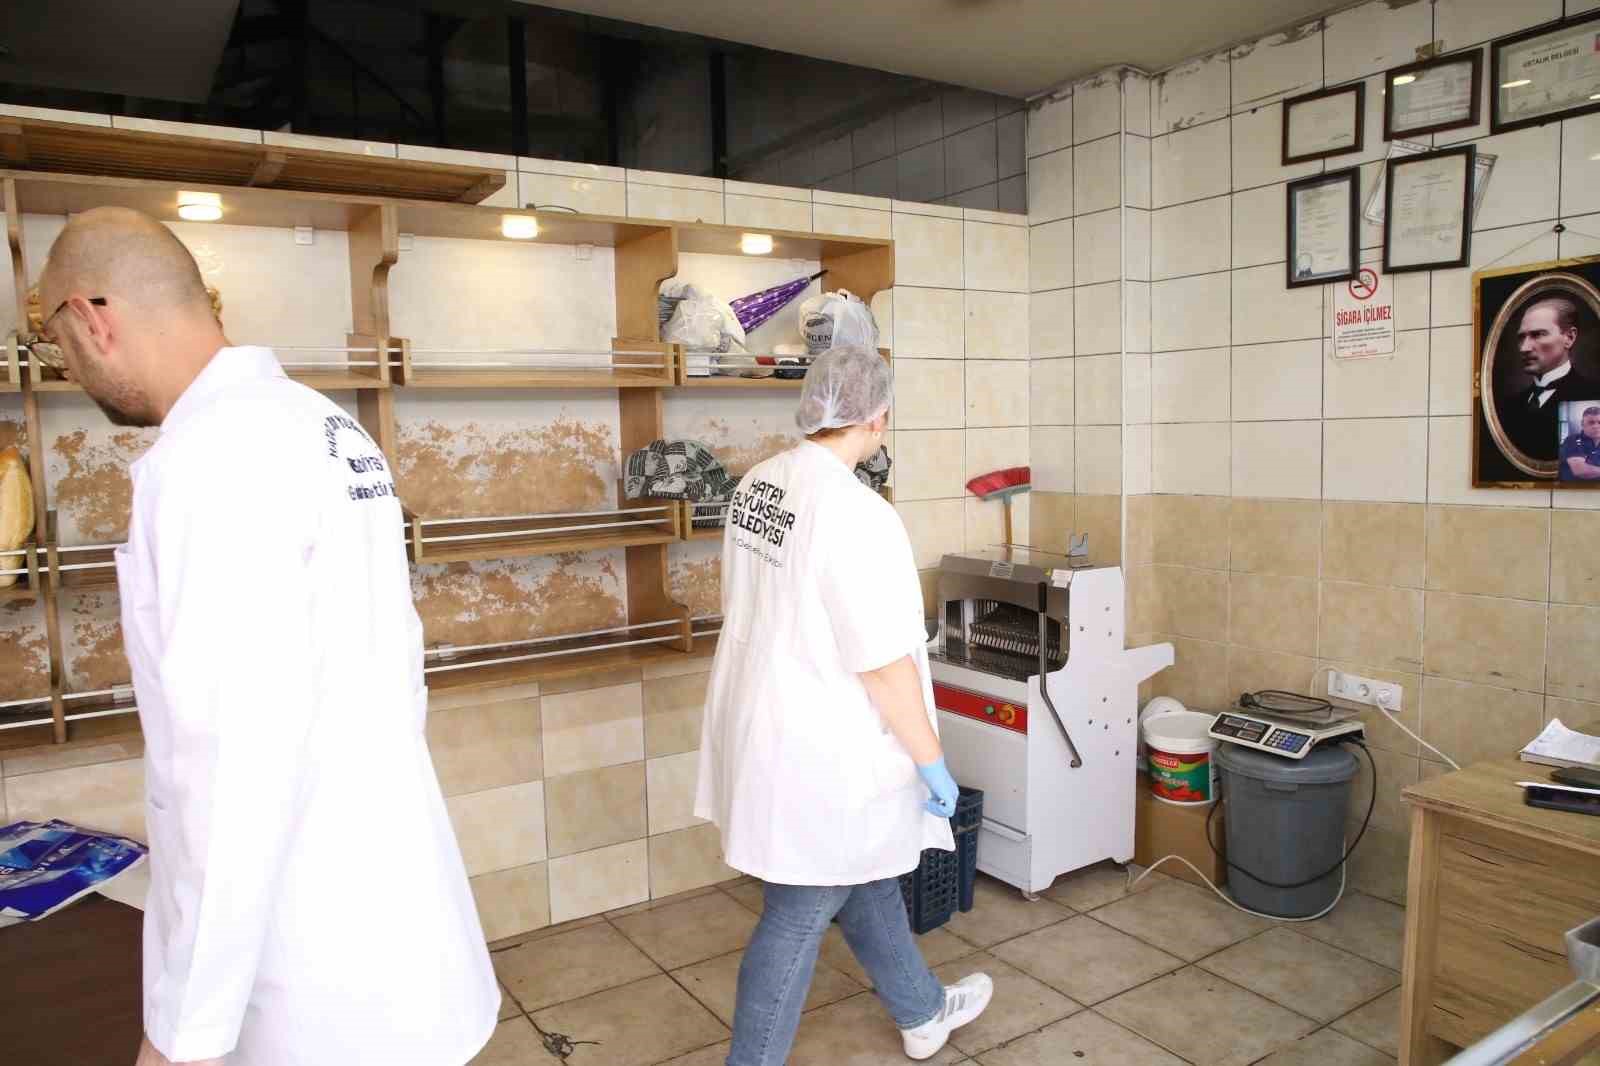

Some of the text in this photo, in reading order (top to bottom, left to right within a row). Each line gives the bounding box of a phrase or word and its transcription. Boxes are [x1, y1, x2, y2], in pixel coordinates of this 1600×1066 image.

[1336, 303, 1392, 327] SİGARA İÇİLMEZ
[749, 479, 786, 503] HATAY
